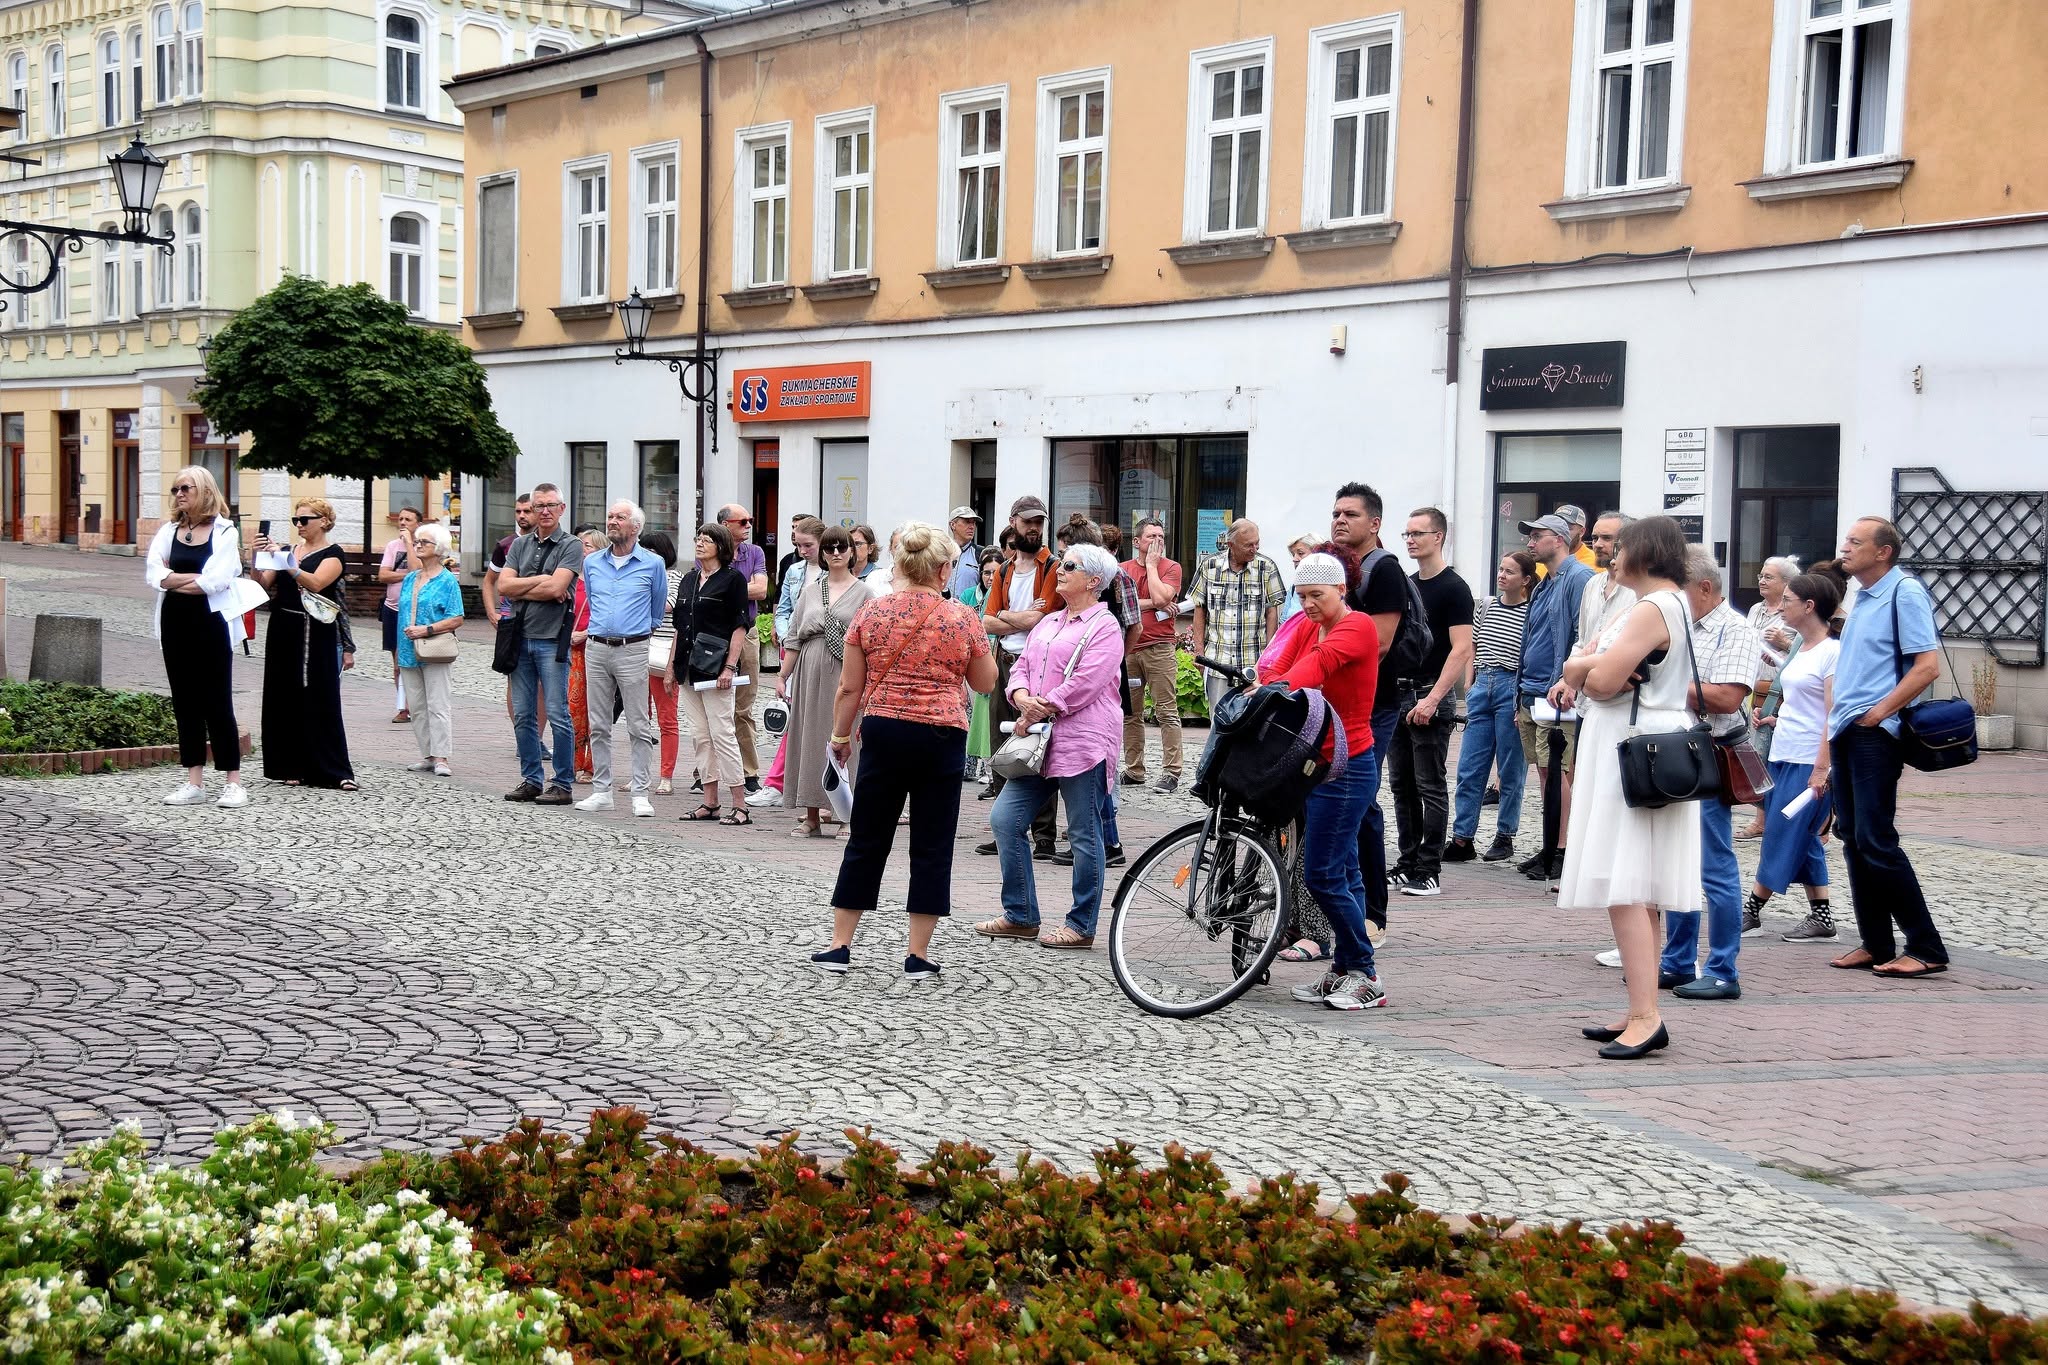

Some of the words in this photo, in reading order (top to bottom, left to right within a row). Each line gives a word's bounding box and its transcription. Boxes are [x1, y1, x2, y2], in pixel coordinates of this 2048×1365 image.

[781, 376, 858, 393] BUKMACHERSKIE
[1486, 365, 1541, 392] Glamour
[1564, 364, 1614, 390] Beauty
[740, 375, 769, 415] STS
[780, 395, 813, 407] ZAKŁADY
[815, 392, 857, 405] SPORTOWE
